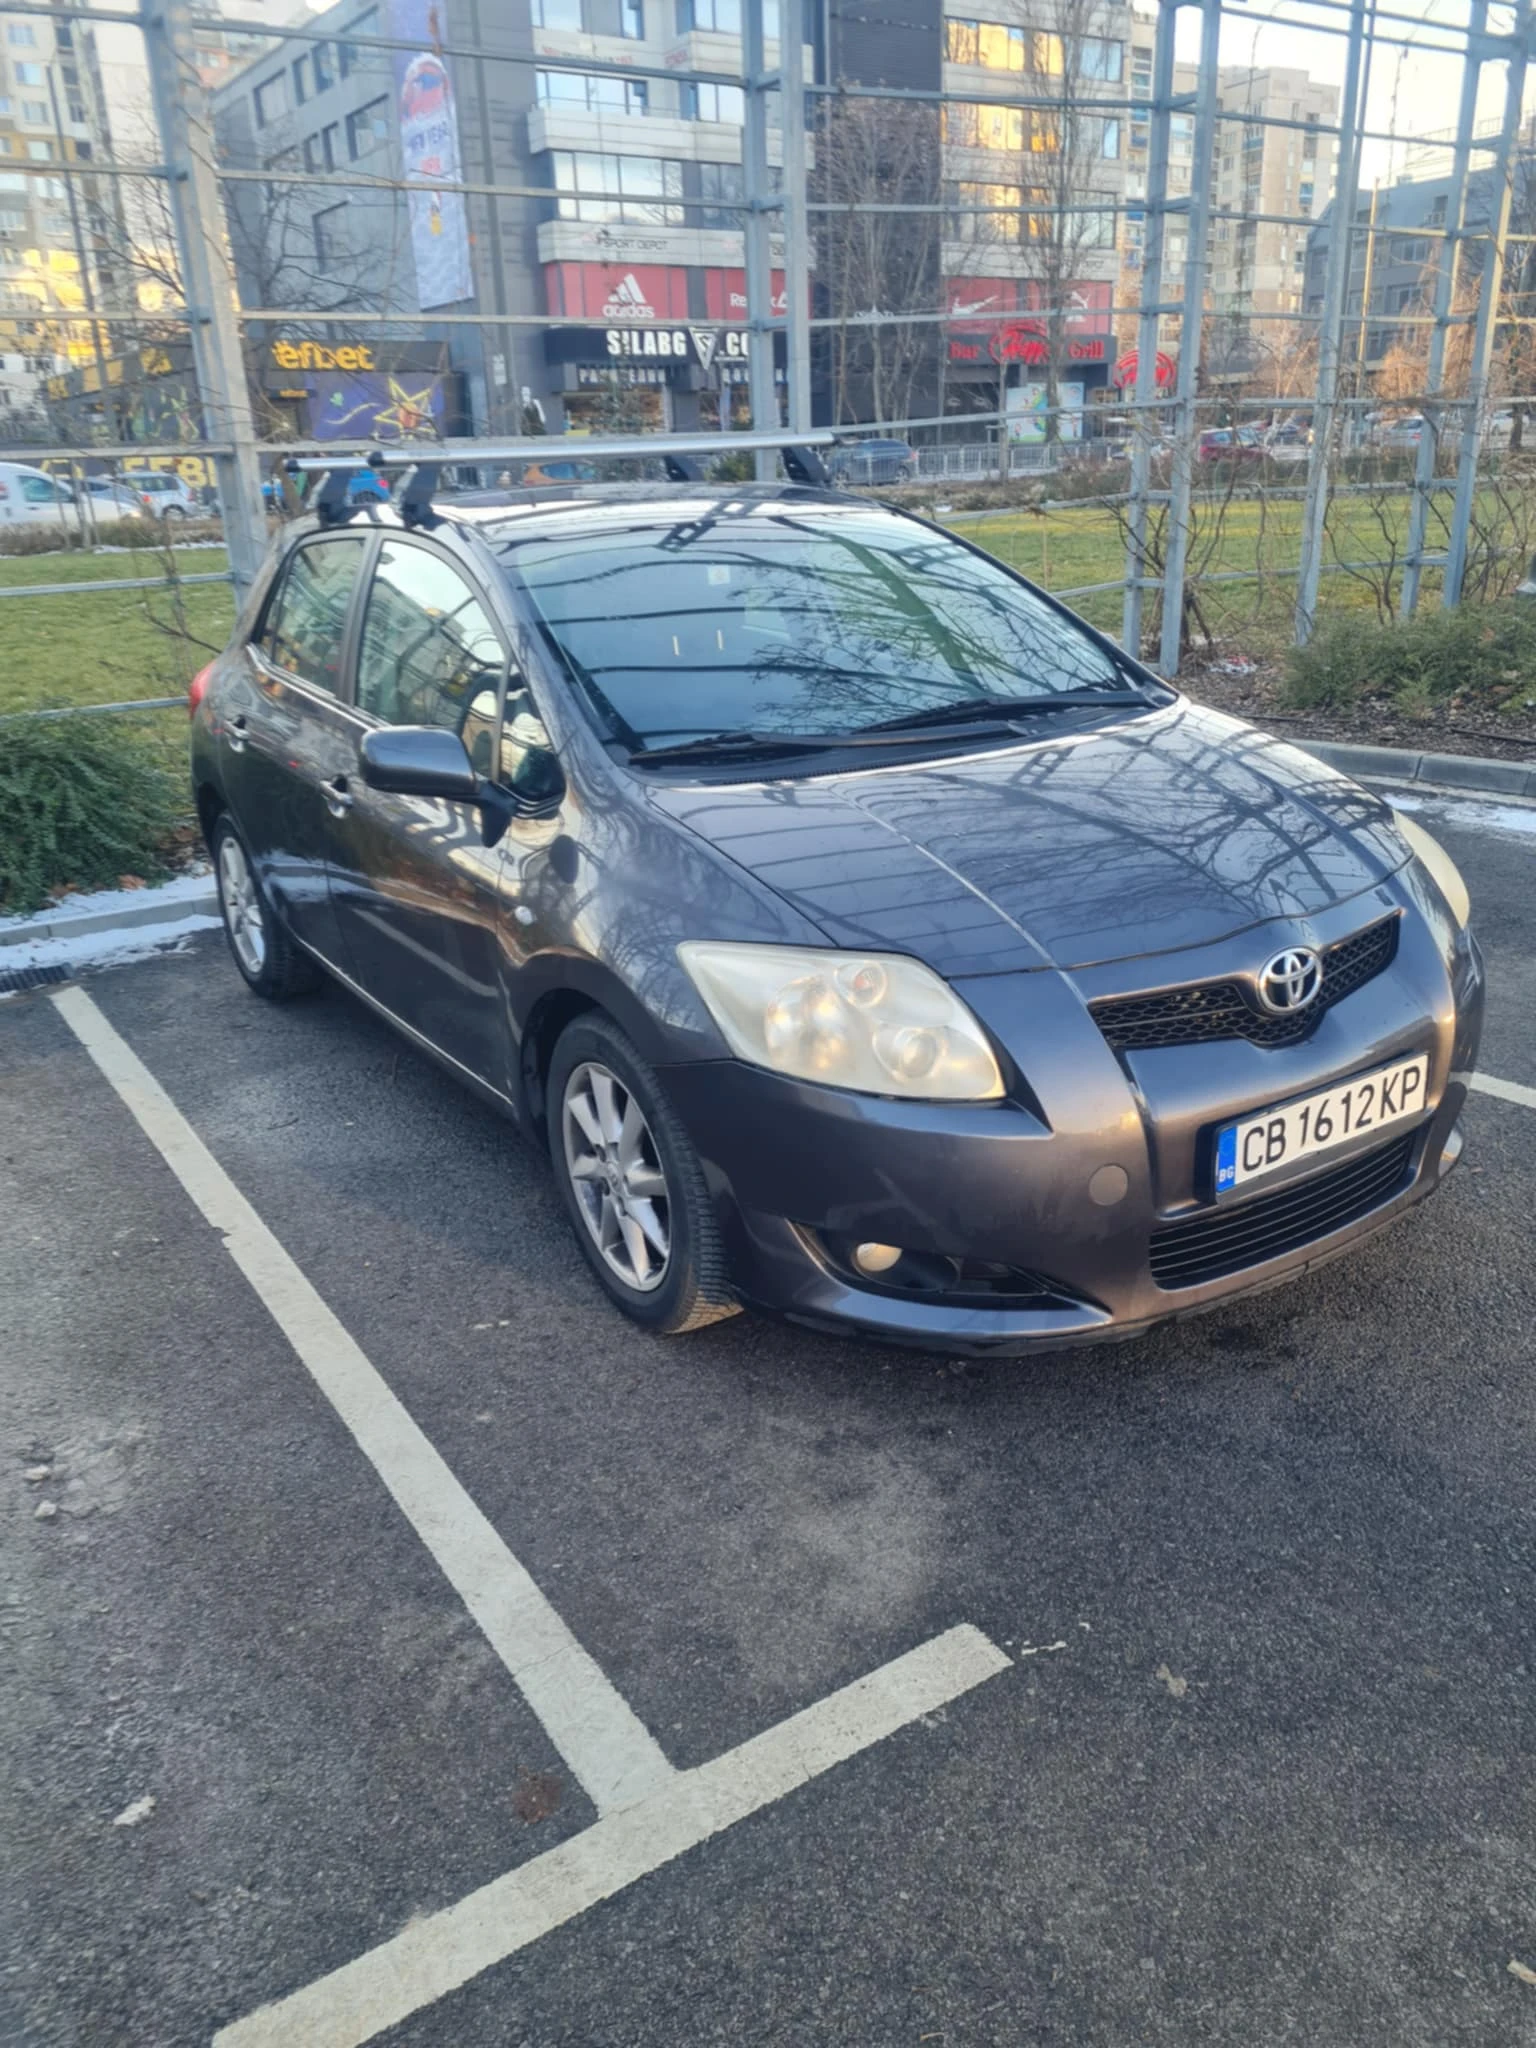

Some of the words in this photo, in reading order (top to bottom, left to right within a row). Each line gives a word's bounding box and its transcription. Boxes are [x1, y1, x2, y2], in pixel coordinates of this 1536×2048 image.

[602, 303, 655, 318] adidas
[273, 341, 374, 369] efbet
[1068, 341, 1105, 360] Grill
[1242, 1117, 1287, 1172] CB
[1218, 1166, 1234, 1182] BG
